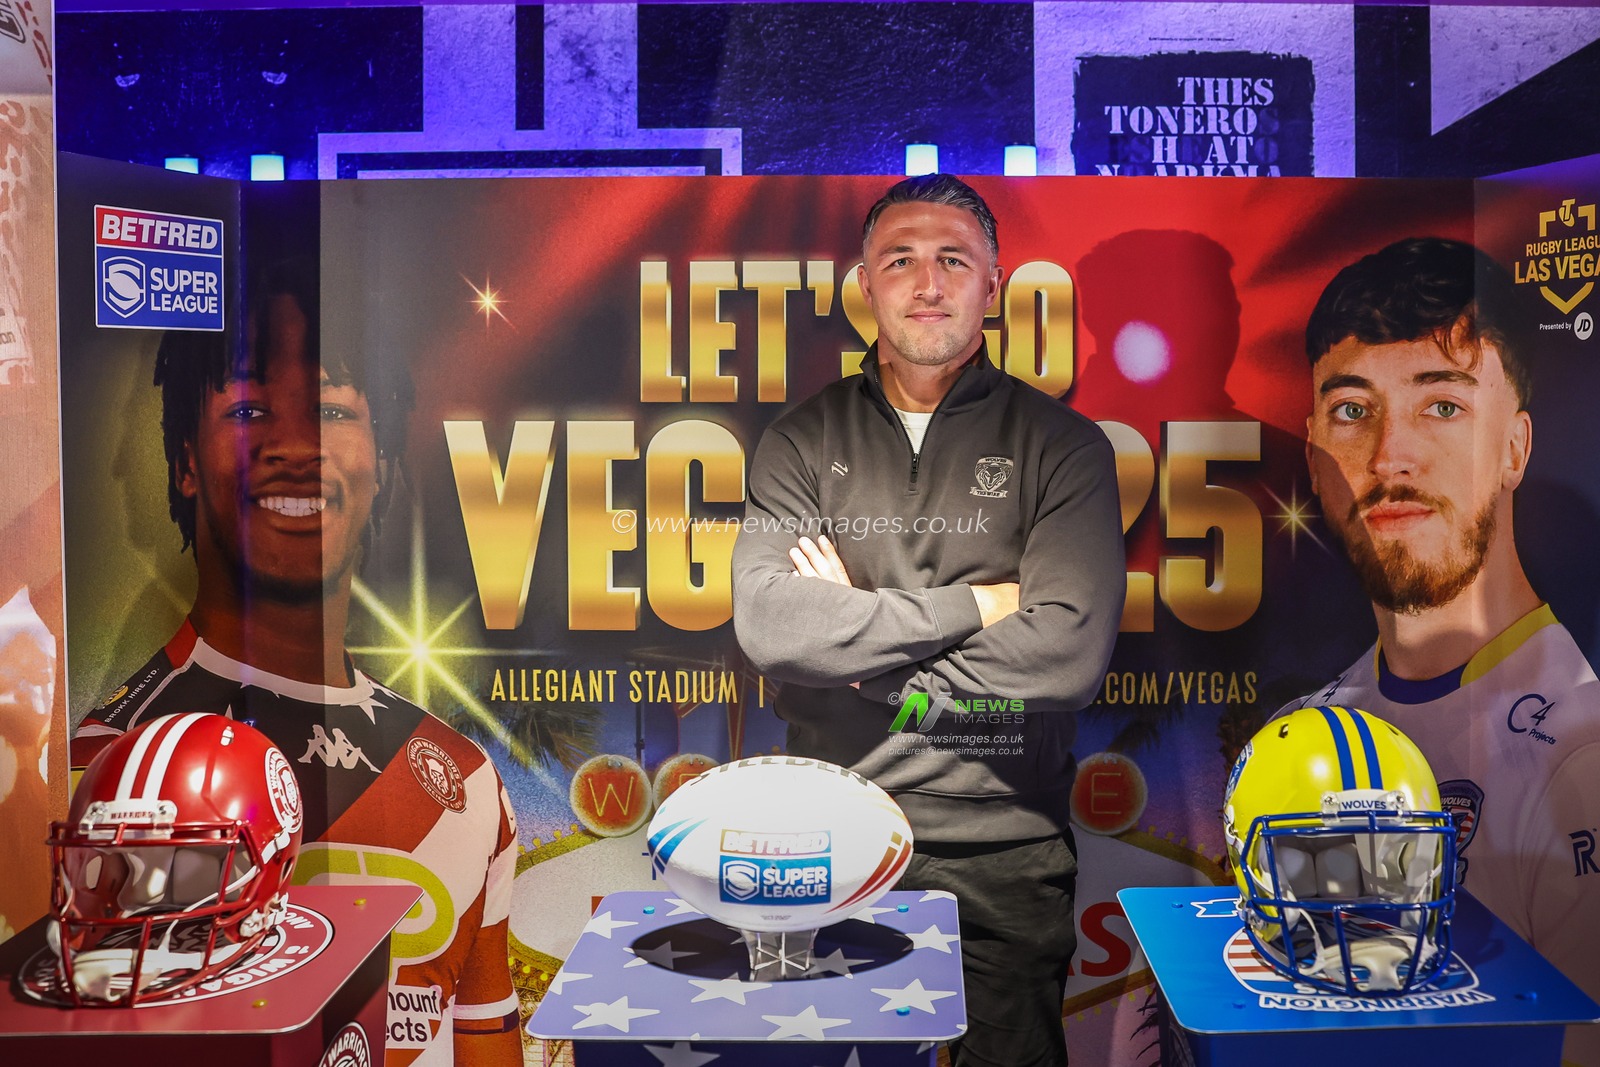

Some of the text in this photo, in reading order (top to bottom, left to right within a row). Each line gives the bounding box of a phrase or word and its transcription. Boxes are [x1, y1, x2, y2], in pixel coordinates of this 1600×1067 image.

[1177, 76, 1275, 106] THES
[101, 213, 218, 250] BETFRED
[1525, 239, 1563, 258] RUGBY
[150, 267, 218, 295] SUPER
[1514, 257, 1551, 285] LAS
[150, 292, 218, 314] LEAGUE
[984, 261, 1074, 400] O
[1539, 321, 1572, 331] Presented by
[1577, 318, 1591, 333] JD
[491, 669, 617, 702] ALLEGIANT
[629, 670, 738, 704] STADIUM
[104, 699, 130, 724] BROKK
[127, 682, 147, 700] HIRE
[1528, 728, 1556, 745] Projects
[1341, 800, 1387, 811] WOLVES
[1440, 796, 1472, 808] WOLVES
[722, 831, 830, 857] BETFRED
[762, 865, 828, 885] SUPER
[763, 883, 828, 899] LEAGUE
[1259, 988, 1494, 1013] WARRINGTON
